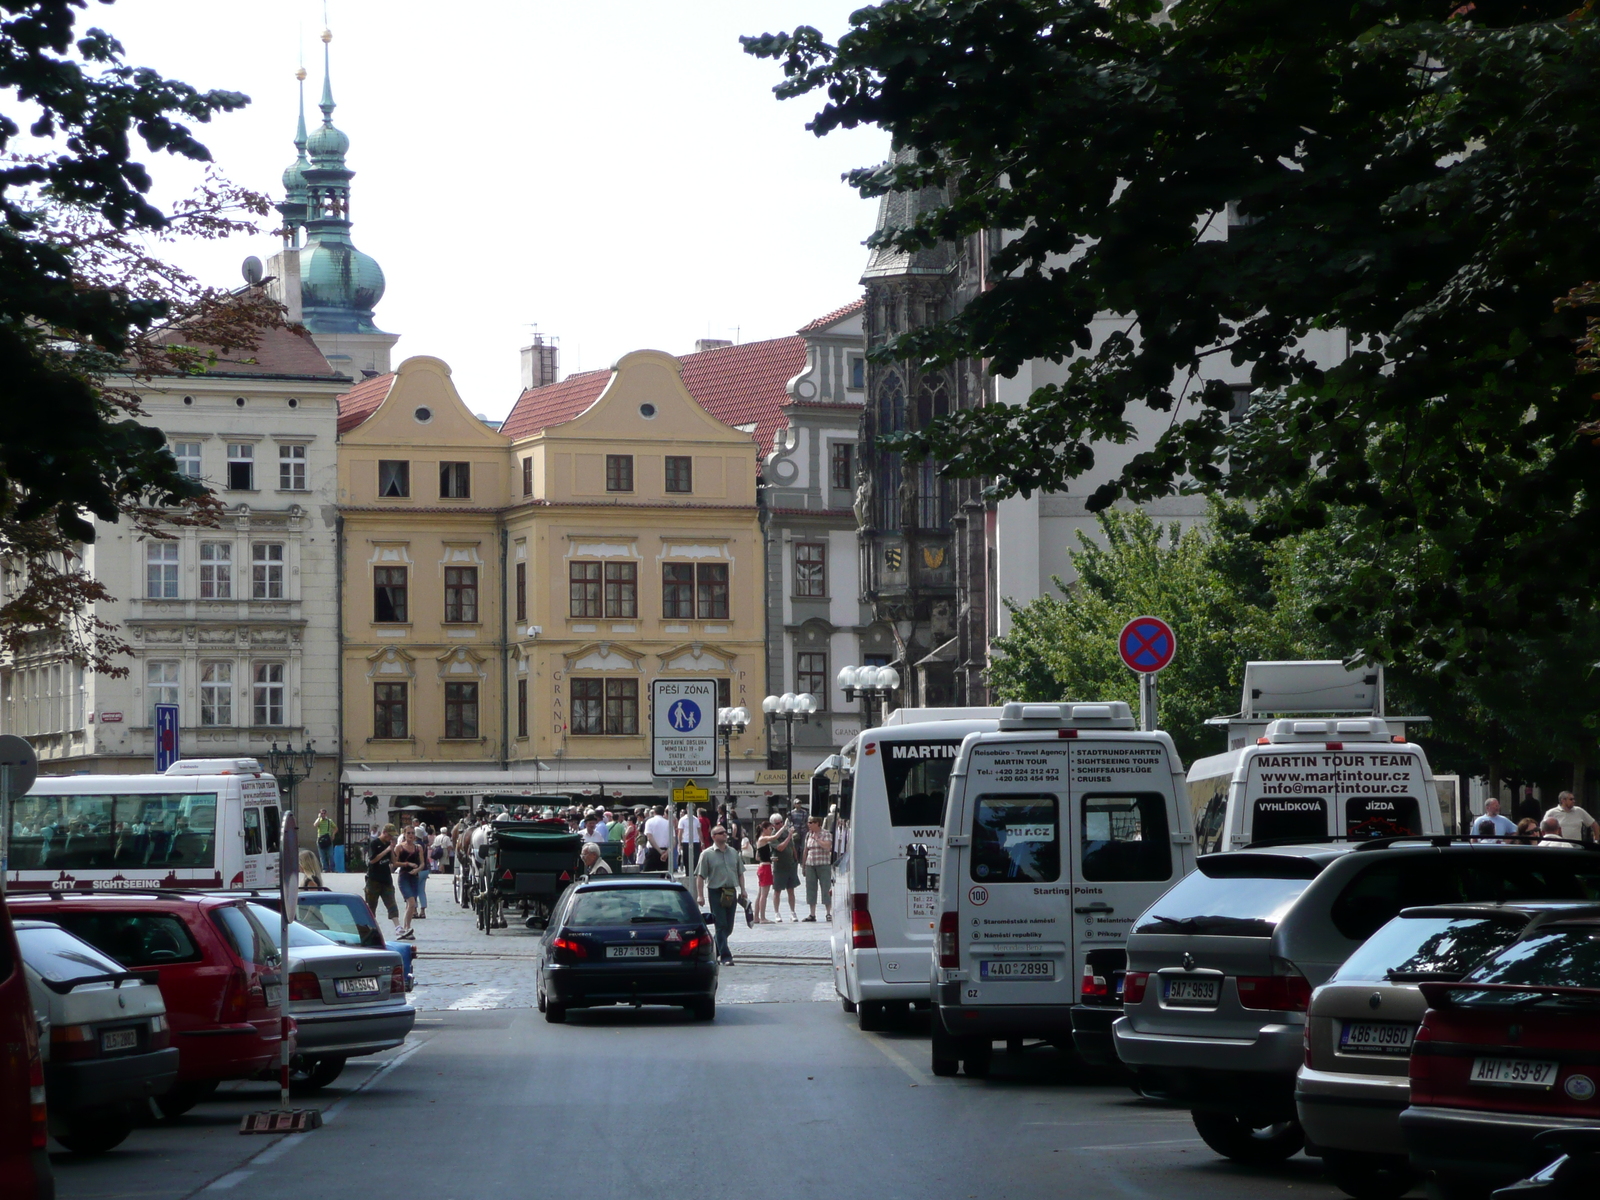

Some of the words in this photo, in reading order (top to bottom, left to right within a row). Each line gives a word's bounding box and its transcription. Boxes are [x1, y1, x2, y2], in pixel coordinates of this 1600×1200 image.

[659, 685, 680, 694] PĚŠÍ
[684, 684, 710, 694] ZÓNA
[553, 671, 562, 734] GRAND
[892, 746, 961, 758] MARTIN
[1258, 756, 1317, 767] MARTIN
[1322, 756, 1364, 766] TOUR
[1370, 756, 1412, 766] TEAM
[1261, 771, 1410, 782] www.martintour.cz
[1263, 782, 1408, 794] info@martintour.cz
[1259, 801, 1321, 811] VYHLÍDKOVÁ
[1366, 801, 1394, 810] JÍZDA
[52, 880, 76, 888] CITY
[93, 880, 160, 888] SIGHTSEEING
[972, 891, 985, 901] 100
[614, 948, 628, 956] 2B7
[636, 947, 655, 955] 1939
[991, 964, 1012, 974] 4A0
[1020, 963, 1048, 974] 2899
[358, 979, 376, 990] 5943
[1172, 982, 1185, 997] 5A7
[1192, 983, 1214, 998] 9639
[1351, 1026, 1371, 1042] 4B6
[1379, 1027, 1408, 1044] 0960
[1478, 1060, 1502, 1079] AHI
[1512, 1062, 1552, 1082] 59-87
